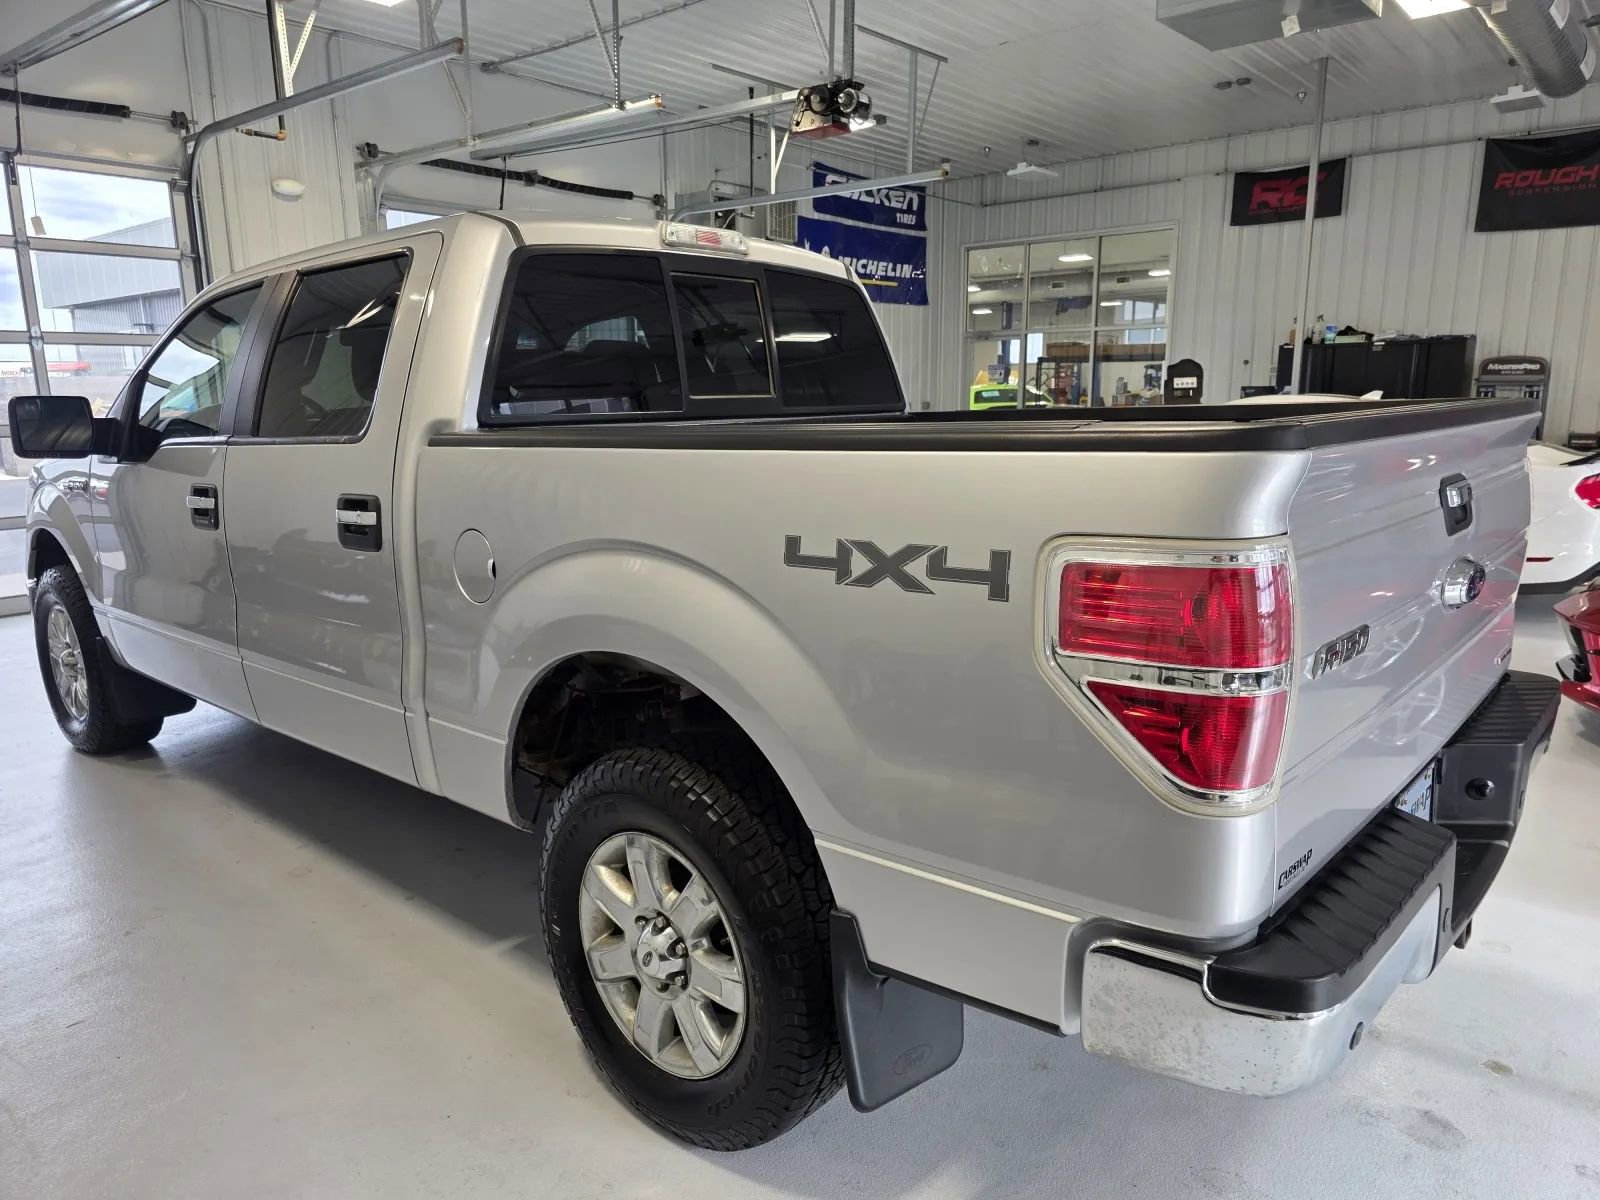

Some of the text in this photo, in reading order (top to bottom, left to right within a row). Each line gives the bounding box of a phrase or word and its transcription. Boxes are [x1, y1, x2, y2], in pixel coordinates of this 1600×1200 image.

[1494, 164, 1600, 189] ROUGH
[896, 213, 916, 225] TIRES
[784, 534, 1011, 603] 4X4
[1278, 848, 1312, 890] CARSWAP
